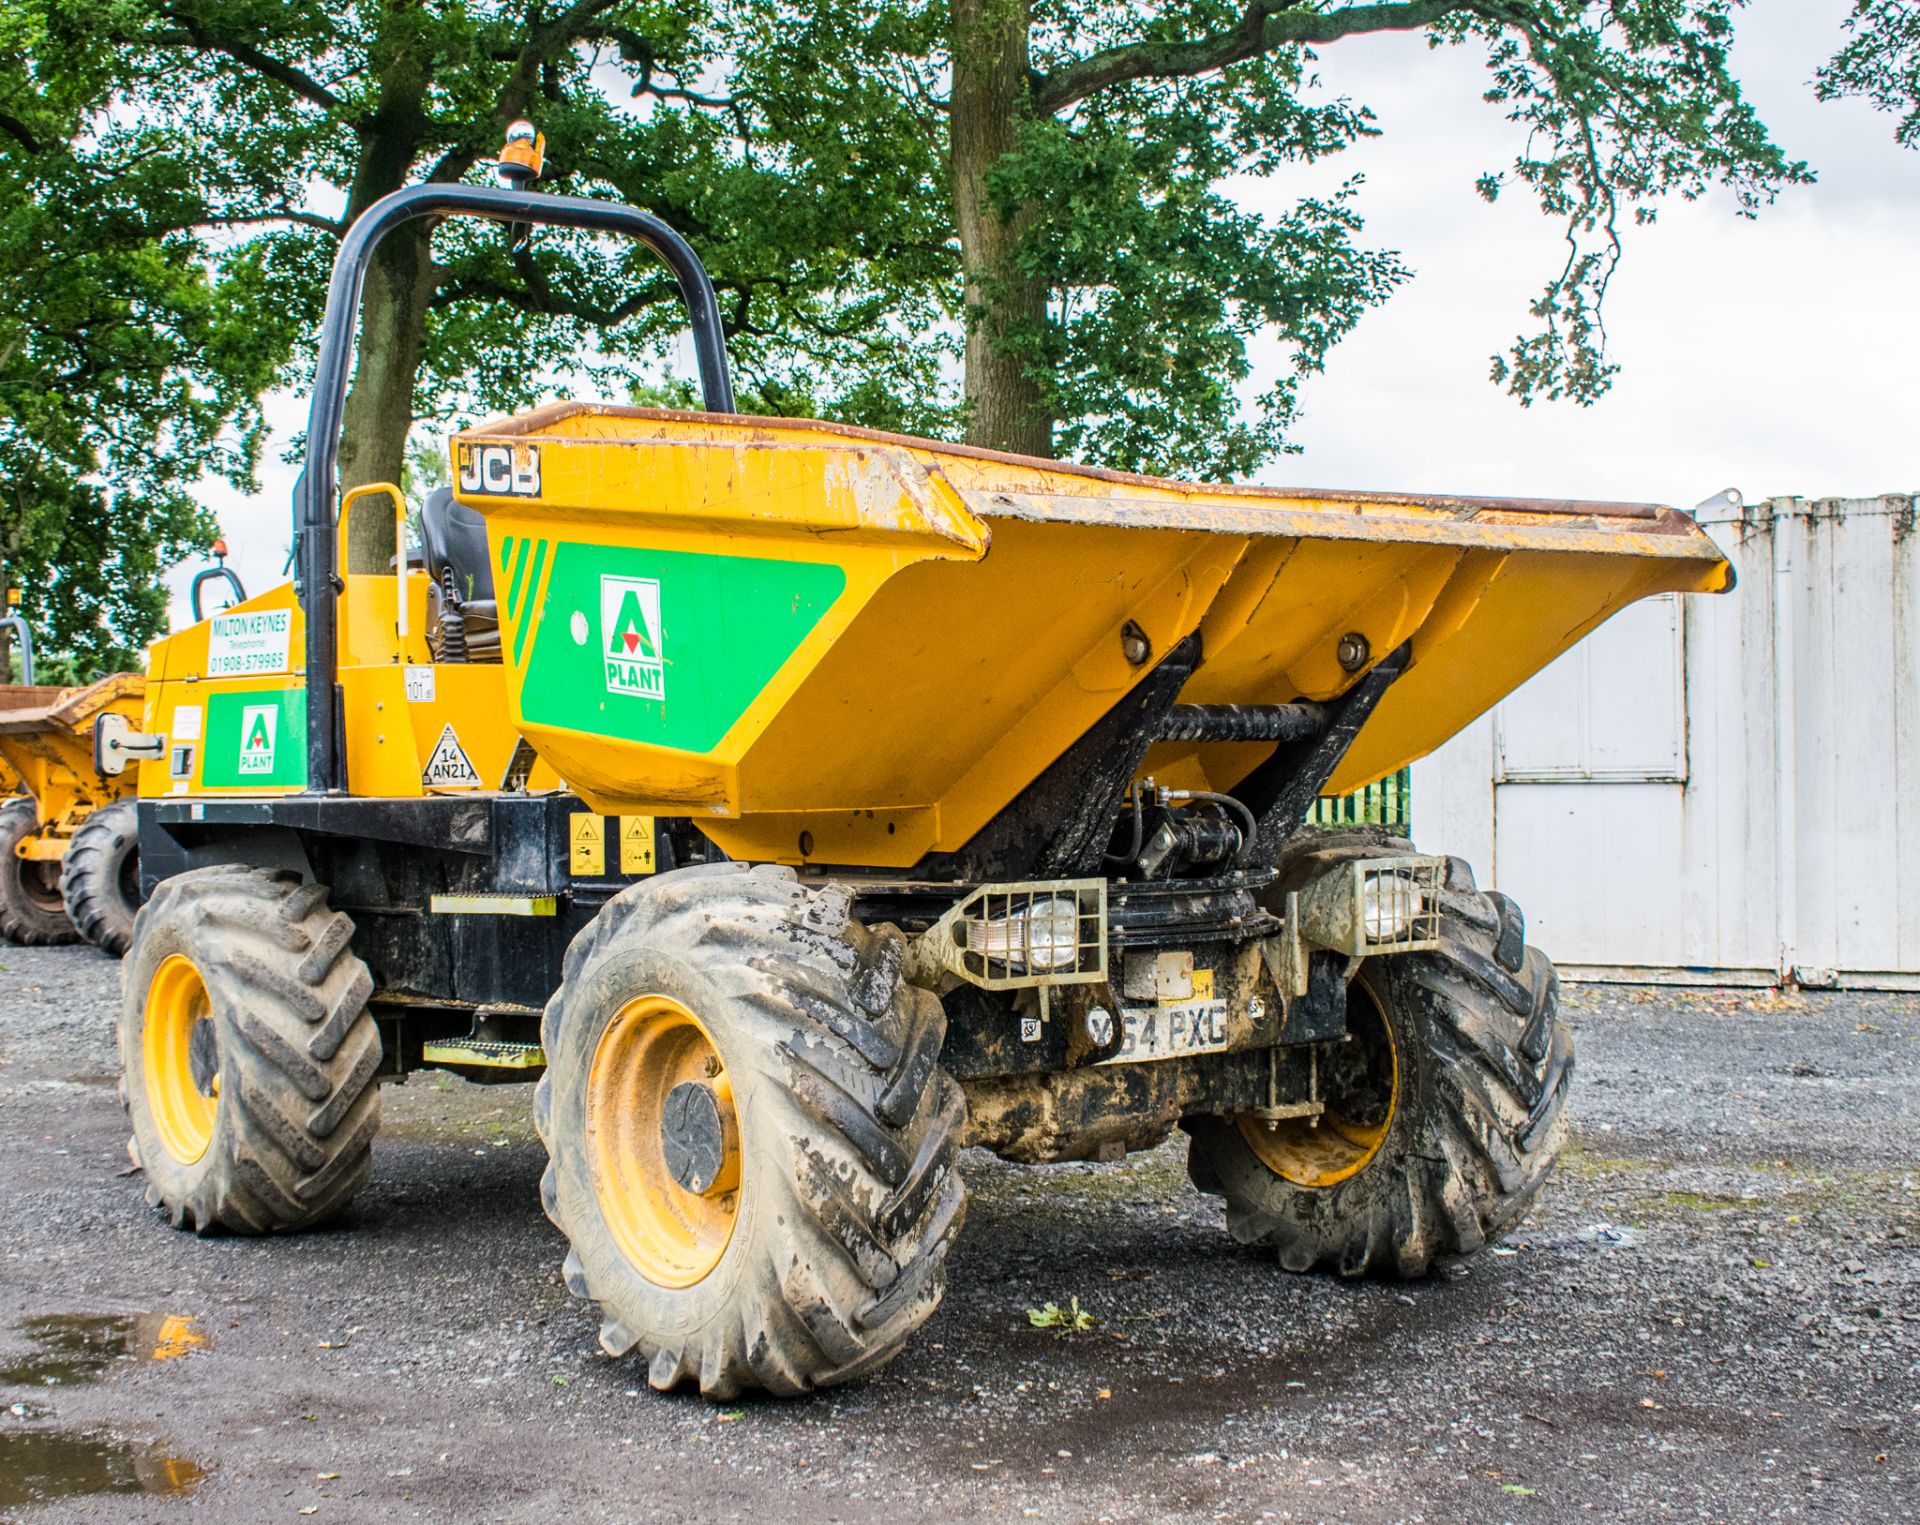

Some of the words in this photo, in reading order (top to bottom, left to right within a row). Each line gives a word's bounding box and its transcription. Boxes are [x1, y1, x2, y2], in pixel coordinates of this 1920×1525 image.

[460, 446, 541, 494] JCB
[212, 617, 248, 637] MILTON
[250, 613, 287, 634] KEYNES
[610, 590, 657, 658] A
[210, 652, 283, 672] 01908-579985
[606, 662, 662, 692] PLANT
[246, 713, 271, 750] A
[240, 755, 273, 769] PLANT
